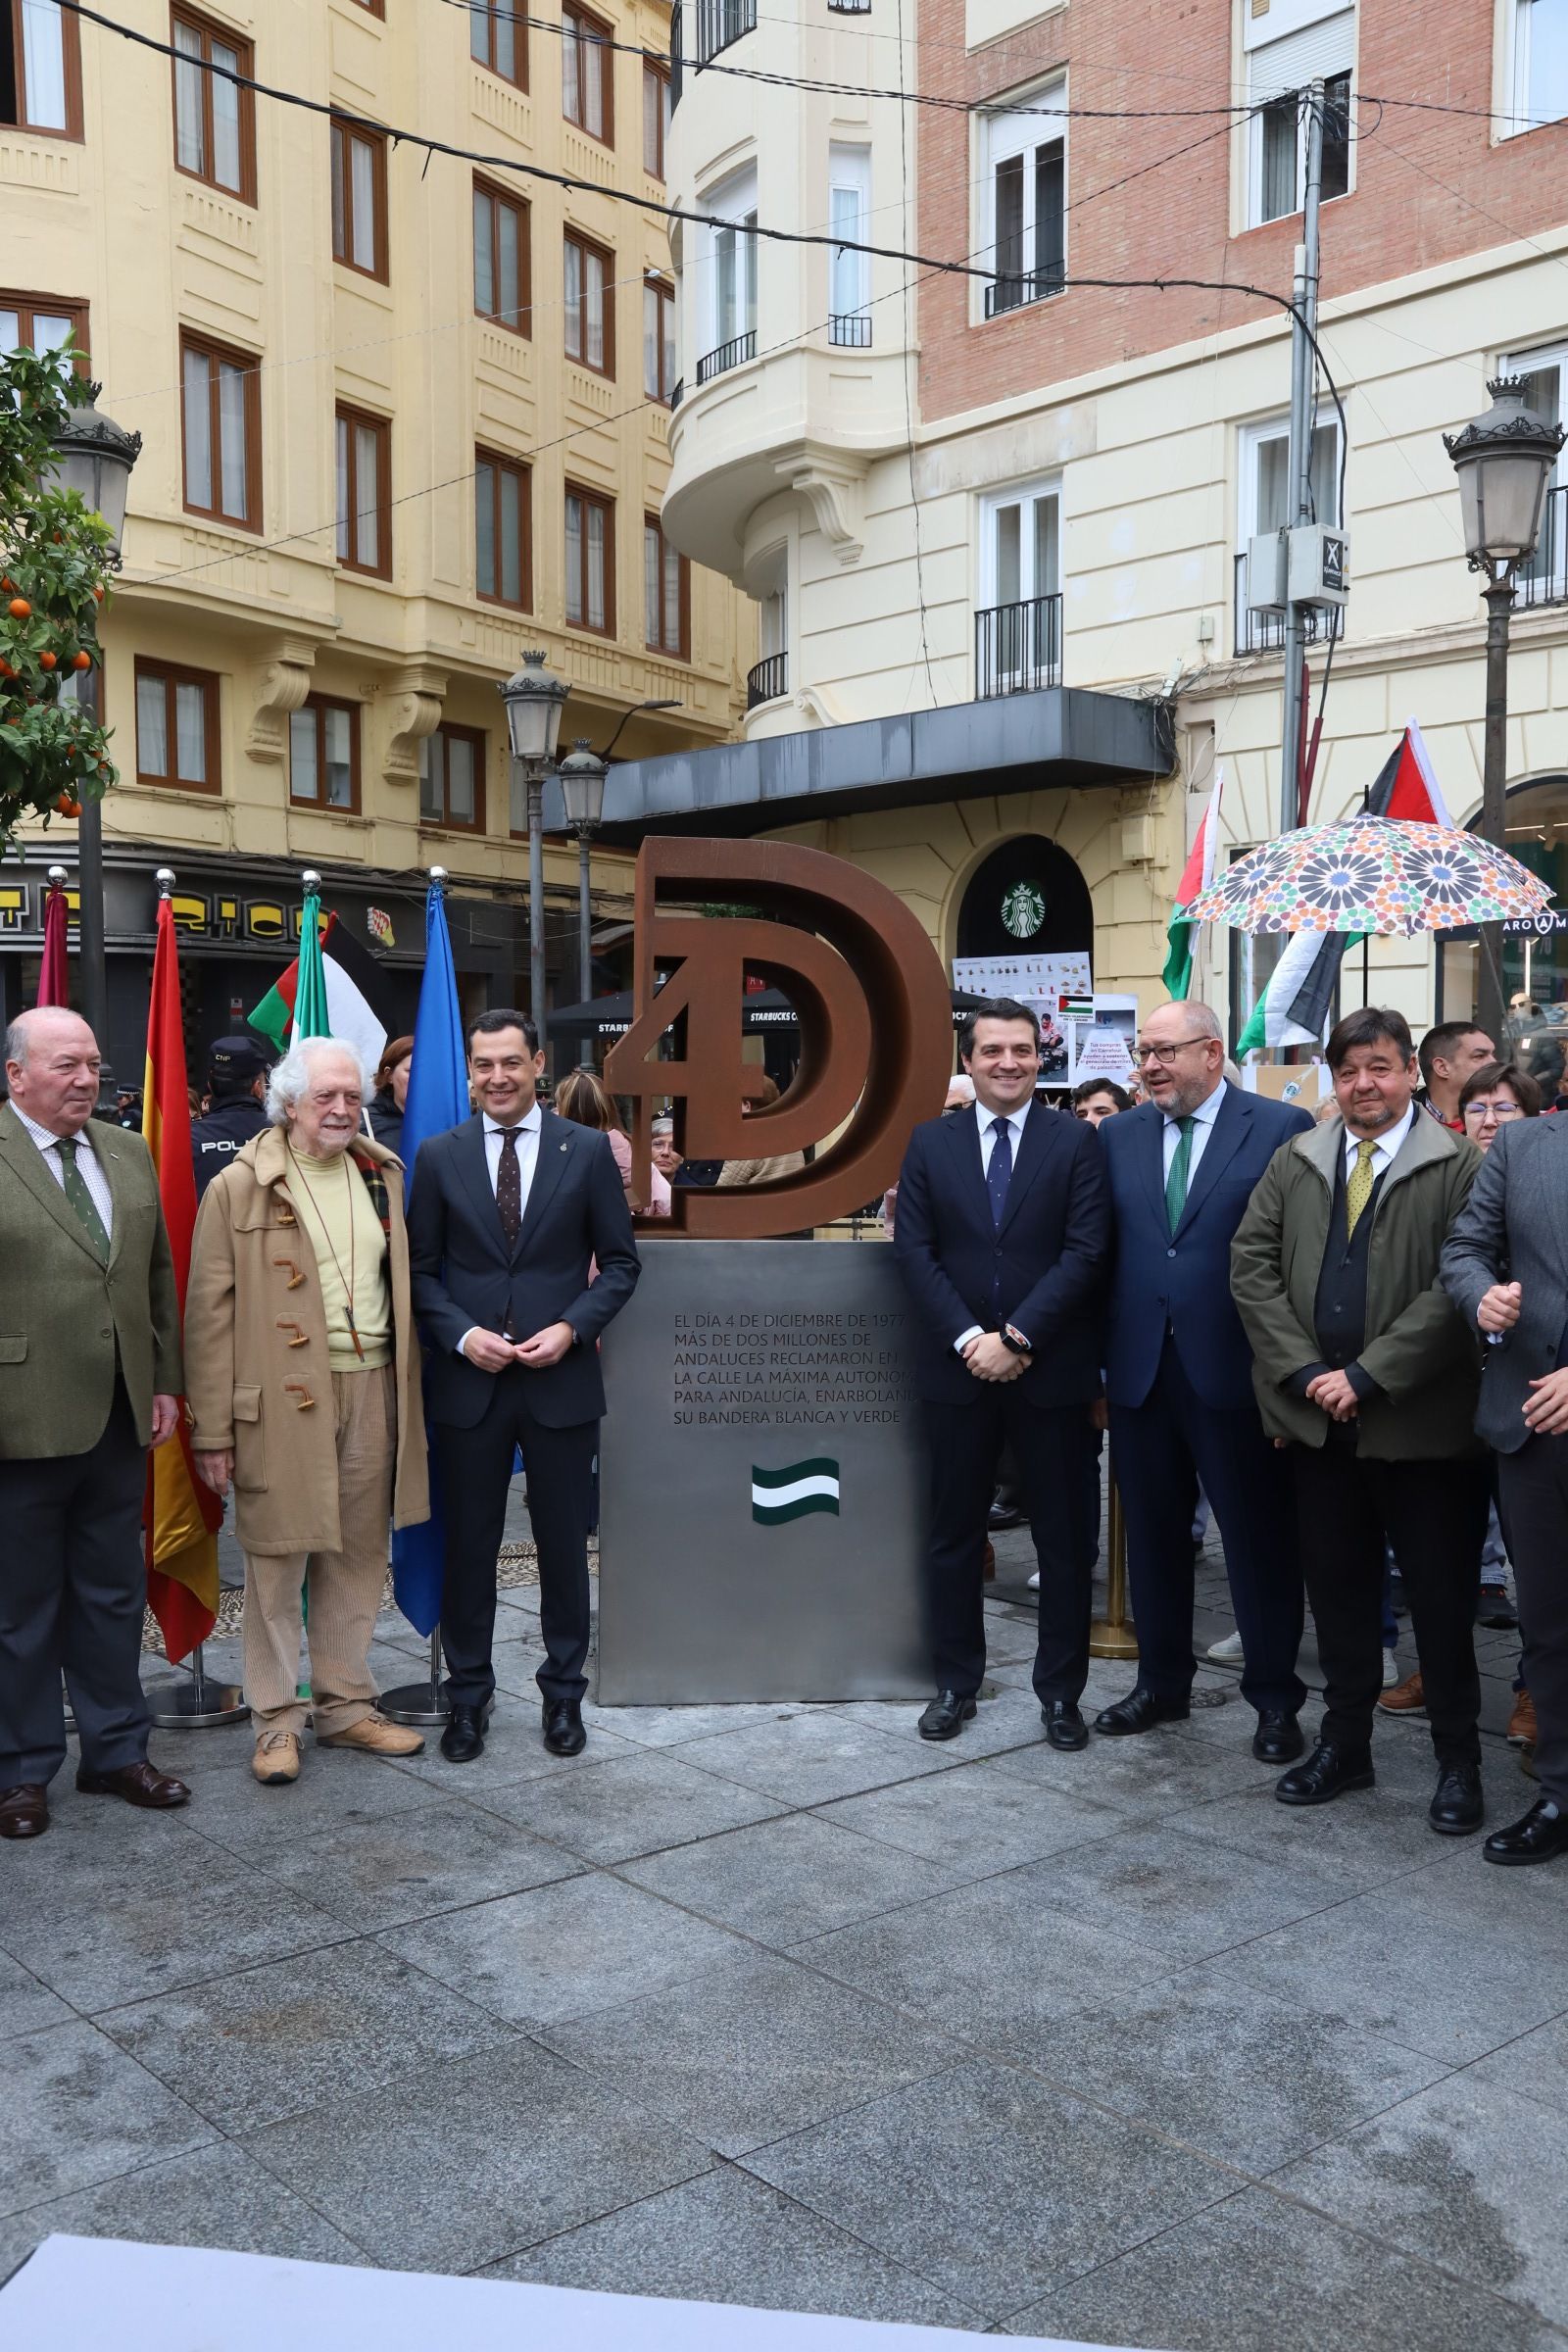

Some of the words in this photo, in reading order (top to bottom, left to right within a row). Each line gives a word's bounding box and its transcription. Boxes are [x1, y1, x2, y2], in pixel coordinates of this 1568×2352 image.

[750, 1012, 790, 1022] STARBUCKS
[791, 1011, 799, 1021] C
[598, 1024, 632, 1033] STARB
[674, 1314, 691, 1328] EL
[695, 1311, 721, 1328] DÍA
[725, 1314, 735, 1328] 4
[740, 1314, 759, 1328] DE
[764, 1314, 843, 1328] DICIEMBRE
[848, 1314, 867, 1327] DE
[873, 1314, 906, 1327] 1977
[674, 1330, 707, 1347] MÁS
[712, 1334, 731, 1347] DE
[737, 1333, 768, 1347] DOS
[773, 1333, 847, 1347] MILLONES
[853, 1333, 871, 1347] DE
[674, 1352, 765, 1365] ANDALUCES
[770, 1352, 873, 1365] RECLAMARON
[879, 1352, 899, 1365] EN
[674, 1372, 692, 1385] LA
[697, 1372, 742, 1385] CALLE
[747, 1372, 764, 1385] LA
[769, 1368, 830, 1384] MÁXIMA
[674, 1391, 713, 1403] PARA
[719, 1387, 810, 1404] ANDALUCÍA,
[815, 1390, 918, 1402] ENARBOLAND
[673, 1411, 693, 1425] SU
[699, 1411, 770, 1424] BANDERA
[775, 1410, 835, 1424] BLANCA
[840, 1410, 849, 1424] Y
[853, 1410, 901, 1423] VERDE
